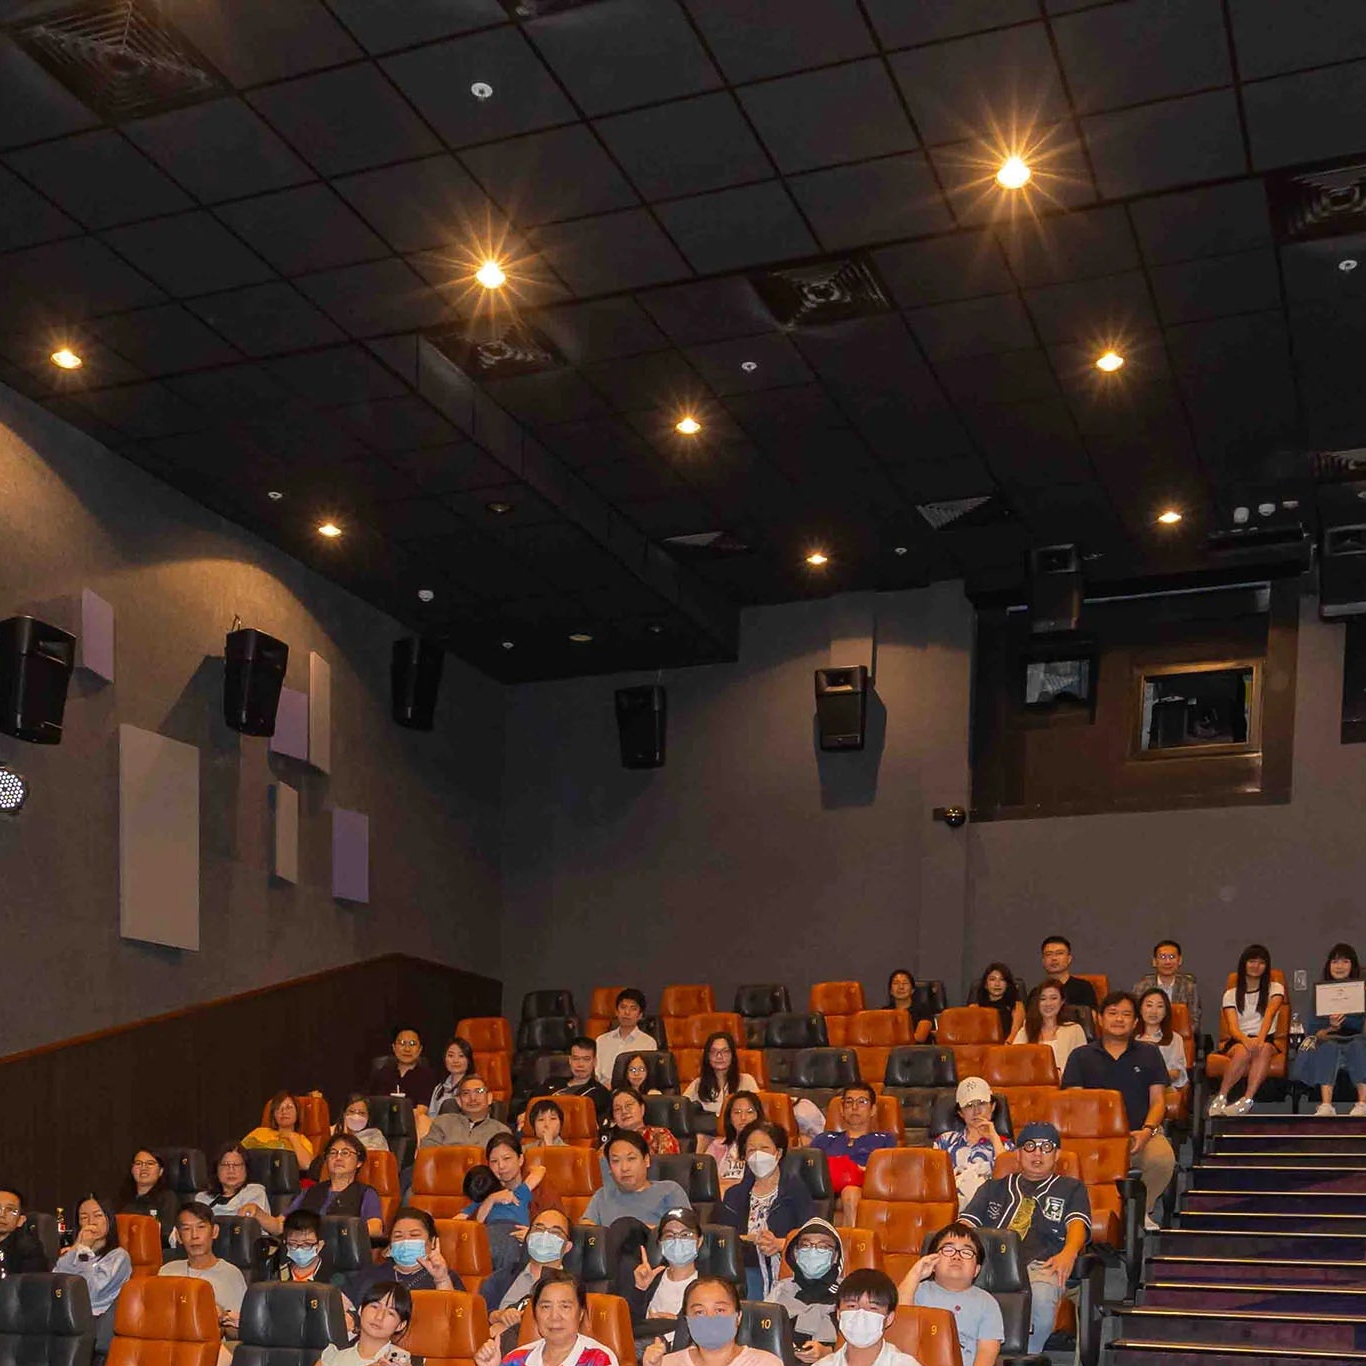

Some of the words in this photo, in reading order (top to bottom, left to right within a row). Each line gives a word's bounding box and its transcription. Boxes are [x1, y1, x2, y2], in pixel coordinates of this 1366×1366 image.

[1000, 1243, 1007, 1254] 9
[760, 1319, 772, 1330] 10
[930, 1325, 938, 1336] 9
